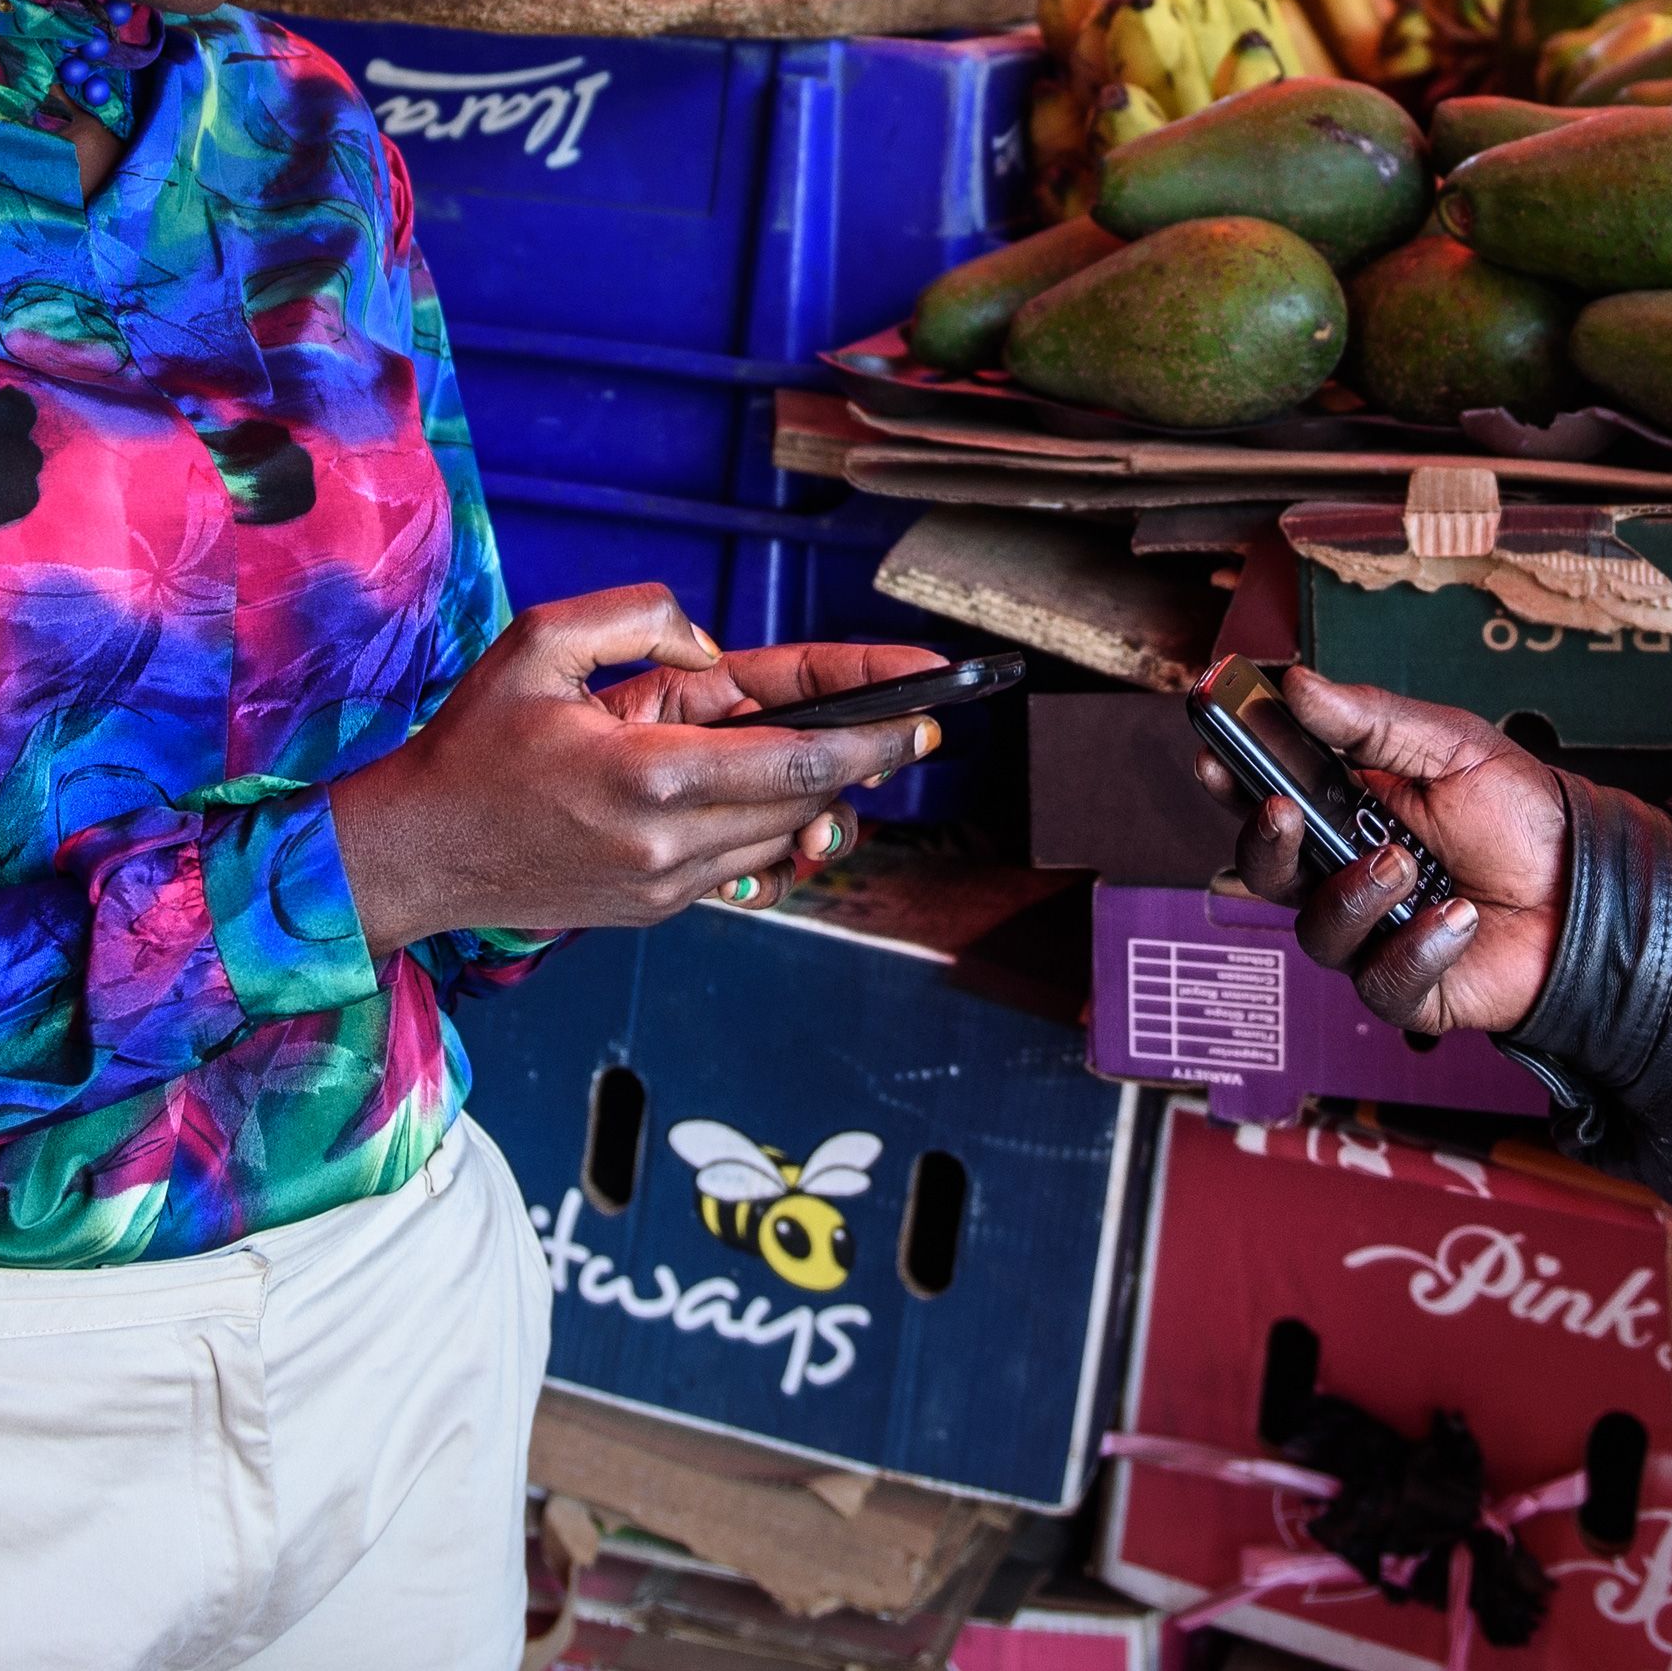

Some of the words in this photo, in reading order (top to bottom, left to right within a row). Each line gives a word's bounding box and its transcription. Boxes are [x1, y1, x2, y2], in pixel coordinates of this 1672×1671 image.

[1228, 953, 1276, 968] Others
[1216, 971, 1276, 986] Crimson
[1179, 986, 1218, 1000] Royal
[1220, 989, 1276, 1005] Autumn
[1247, 1011, 1276, 1024] Red
[1232, 1028, 1276, 1043] Flame
[1172, 1066, 1244, 1086] VARIETY
[1342, 1224, 1661, 1348] Pink
